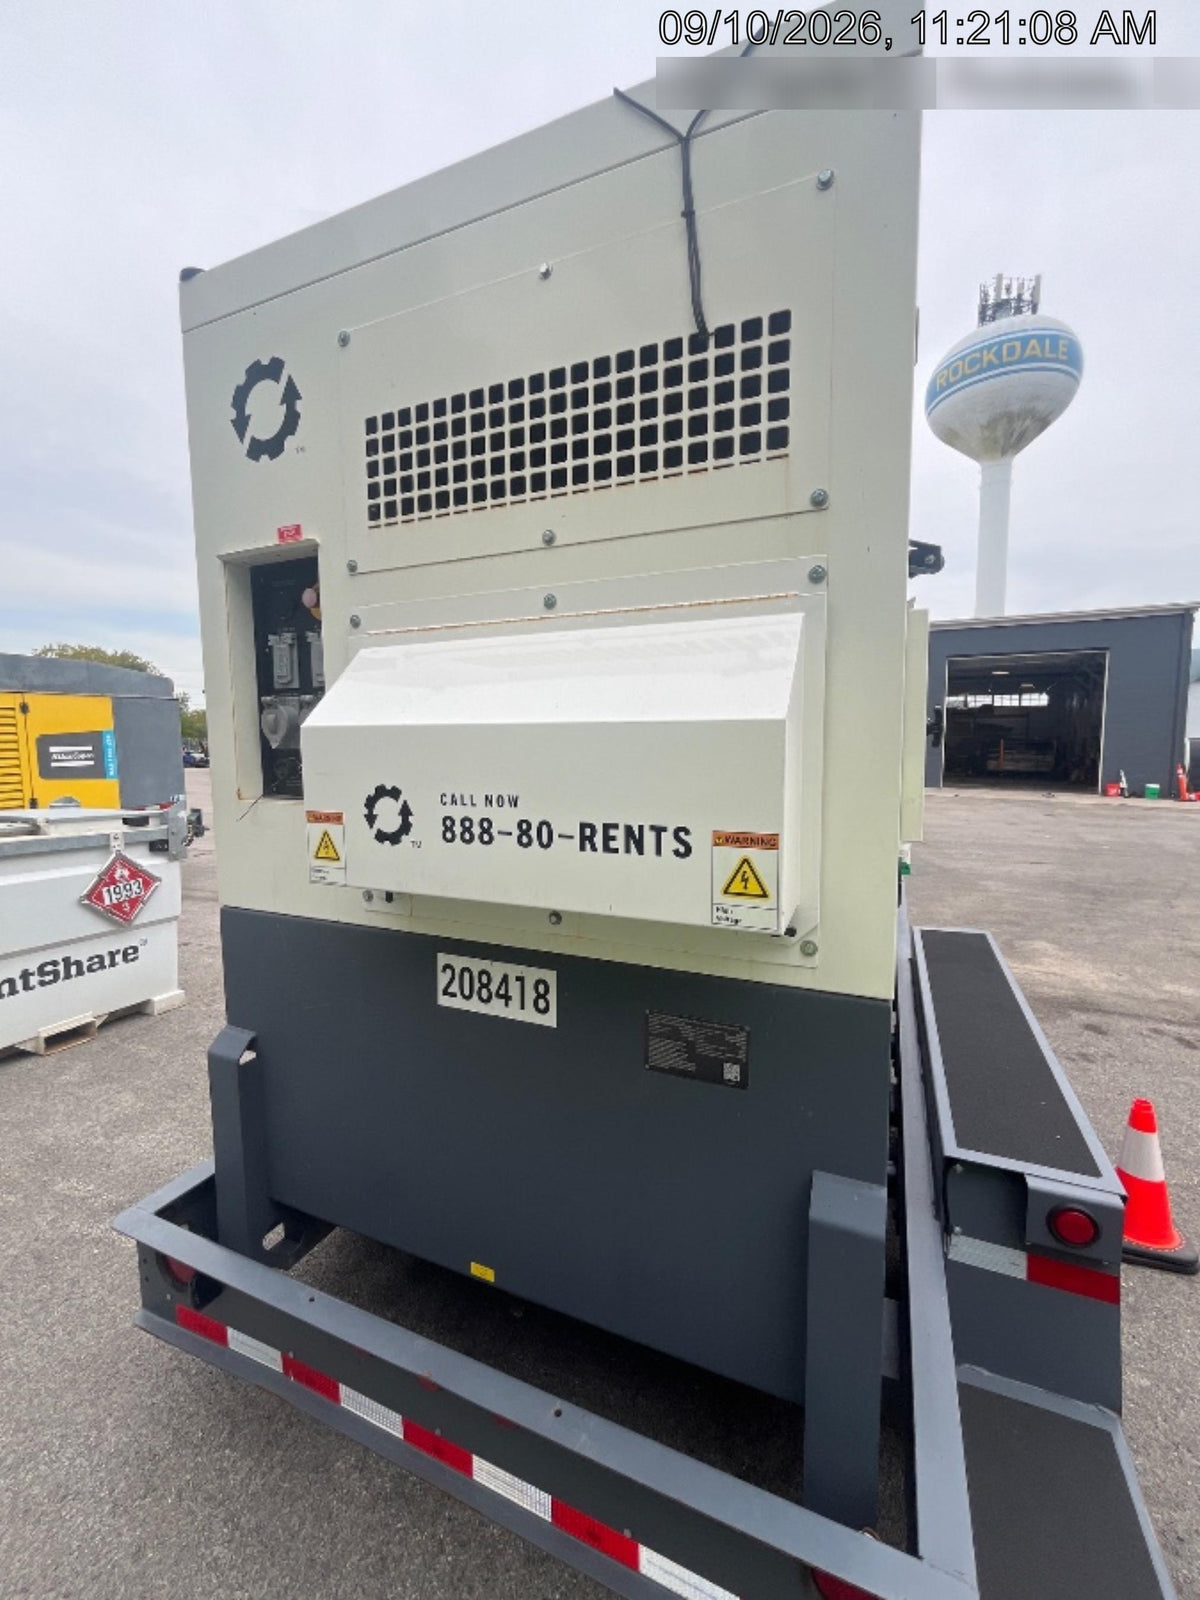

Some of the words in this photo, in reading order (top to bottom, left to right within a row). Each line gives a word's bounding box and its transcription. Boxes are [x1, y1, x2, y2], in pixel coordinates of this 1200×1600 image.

[935, 338, 1070, 391] ROCKDALE
[440, 792, 477, 807] CALL
[485, 794, 519, 808] NOW
[441, 815, 693, 859] 888-80-RENTS
[724, 835, 777, 847] WARNING
[106, 880, 142, 902] 1993
[441, 963, 550, 1015] 208418
